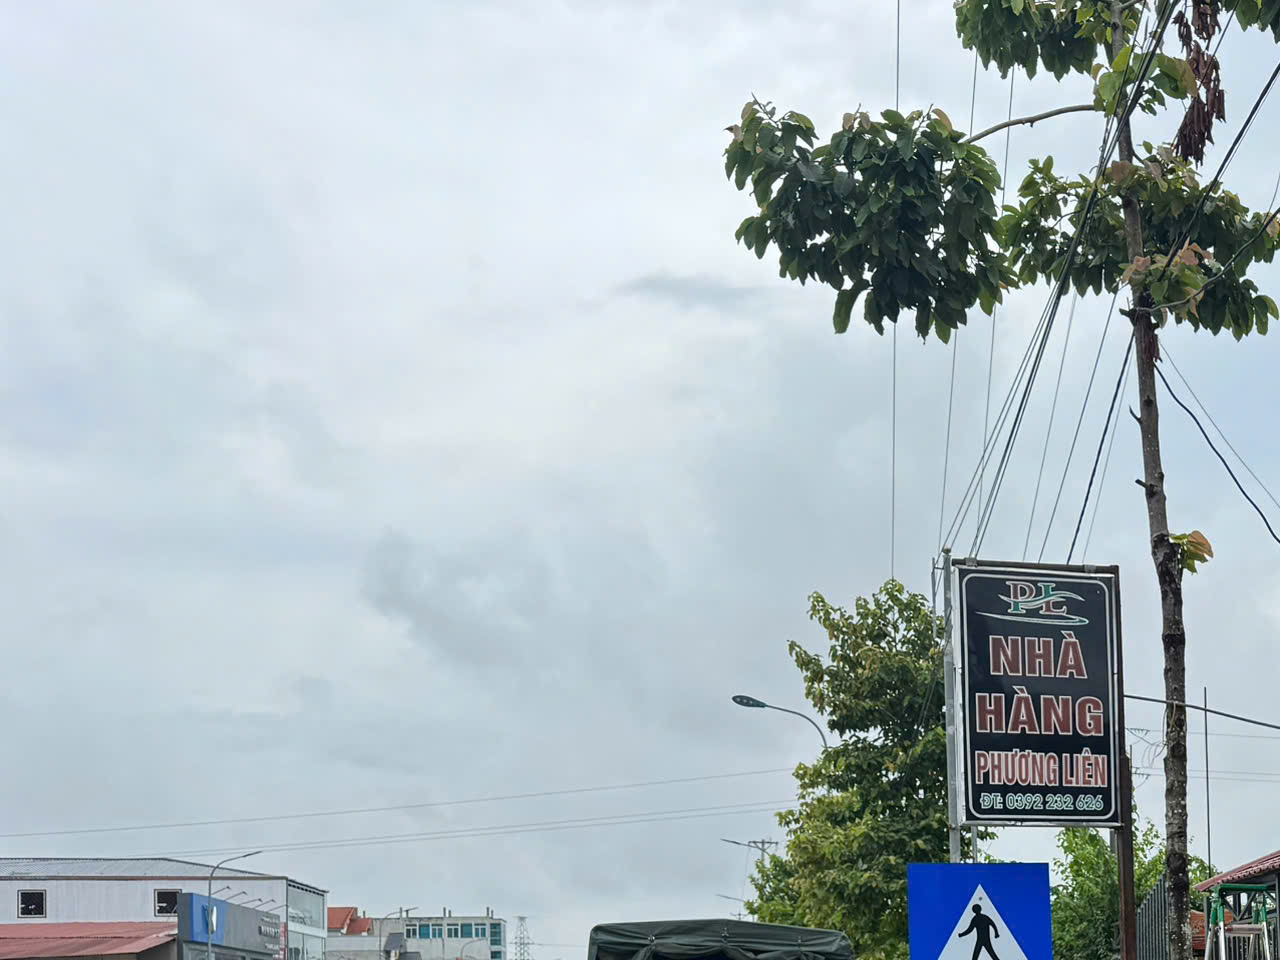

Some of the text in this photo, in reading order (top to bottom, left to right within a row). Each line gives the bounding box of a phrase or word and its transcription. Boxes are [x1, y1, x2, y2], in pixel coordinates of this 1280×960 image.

[989, 630, 1087, 679] NHÀ
[976, 685, 1104, 737] HÀNG
[975, 747, 1107, 788] PHƯƠNG LIÊN
[1005, 793, 1043, 810] 0392
[1045, 794, 1074, 811] 232
[1075, 795, 1104, 811] 626
